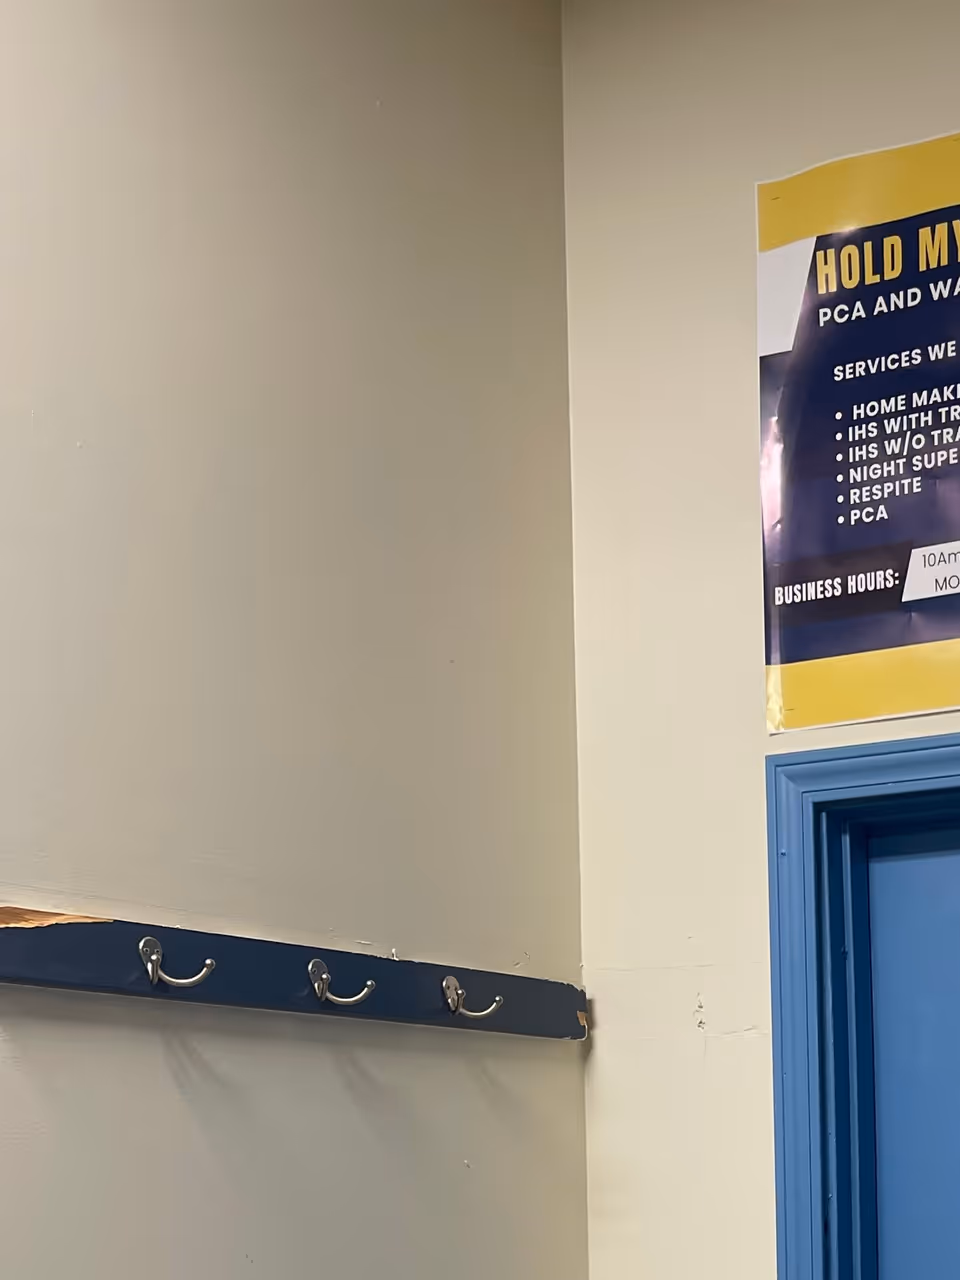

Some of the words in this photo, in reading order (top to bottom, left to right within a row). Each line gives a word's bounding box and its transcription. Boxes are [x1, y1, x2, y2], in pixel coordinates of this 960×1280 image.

[816, 235, 902, 294] HOLD
[818, 303, 866, 326] PCA
[873, 288, 921, 316] AND
[833, 349, 921, 381] SERVICES
[927, 341, 956, 362] WE
[852, 395, 906, 420] HOME
[848, 422, 878, 442] IHS
[884, 412, 932, 435] WITH
[848, 442, 878, 464] IHS
[884, 432, 926, 456] W/O
[849, 458, 907, 484] NIGHT
[849, 476, 922, 505] RESPITE
[850, 504, 889, 526] PCA
[774, 577, 843, 606] BUSINESS
[847, 568, 900, 595] HOURS:
